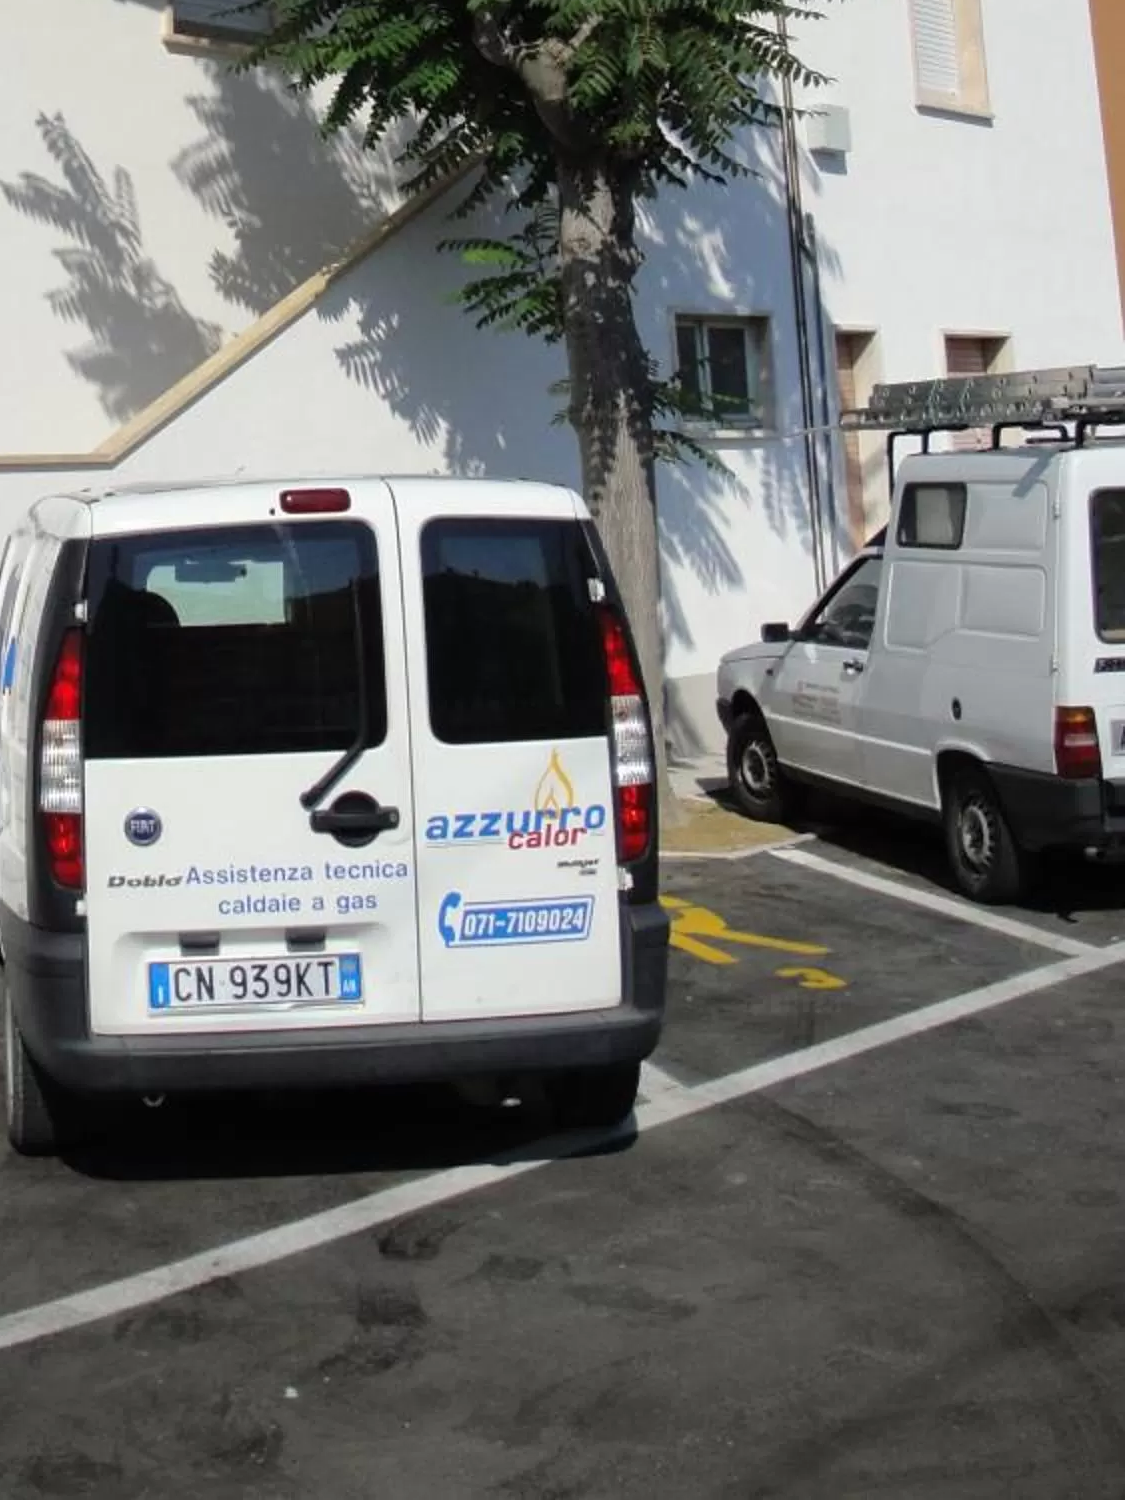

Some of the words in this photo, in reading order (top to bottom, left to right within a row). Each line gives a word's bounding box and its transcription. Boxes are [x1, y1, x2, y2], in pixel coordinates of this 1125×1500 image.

[425, 803, 606, 840] azzurro
[507, 823, 587, 850] calor
[186, 864, 313, 885] Assistenza
[325, 860, 408, 880] tecnica
[218, 894, 301, 915] caldaie
[312, 896, 324, 911] a
[336, 893, 378, 914] gas
[464, 906, 584, 938] 071-7109024
[174, 966, 215, 1002] CN
[229, 961, 335, 1000] 939KT
